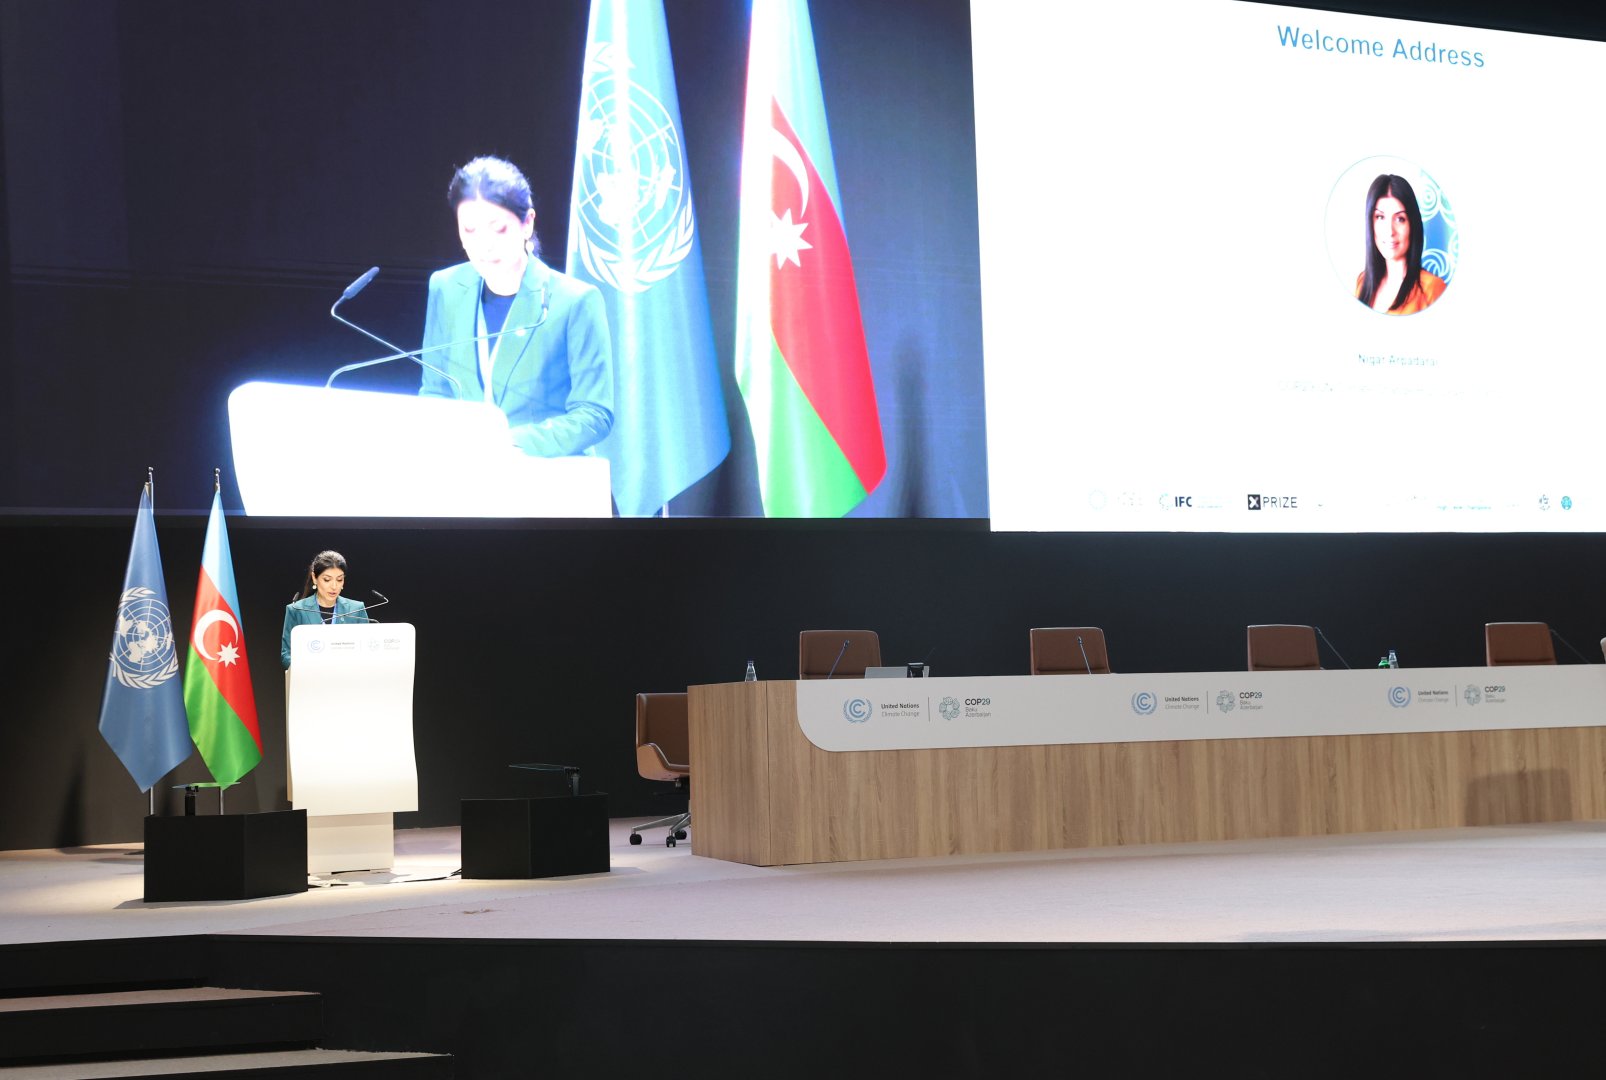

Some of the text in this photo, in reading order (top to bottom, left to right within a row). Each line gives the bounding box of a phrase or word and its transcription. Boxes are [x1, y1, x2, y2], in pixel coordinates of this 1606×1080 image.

[1277, 25, 1485, 68] Welcome Address
[1174, 496, 1193, 508] IFC
[1484, 685, 1506, 693] COP29
[965, 698, 991, 706] COP29
